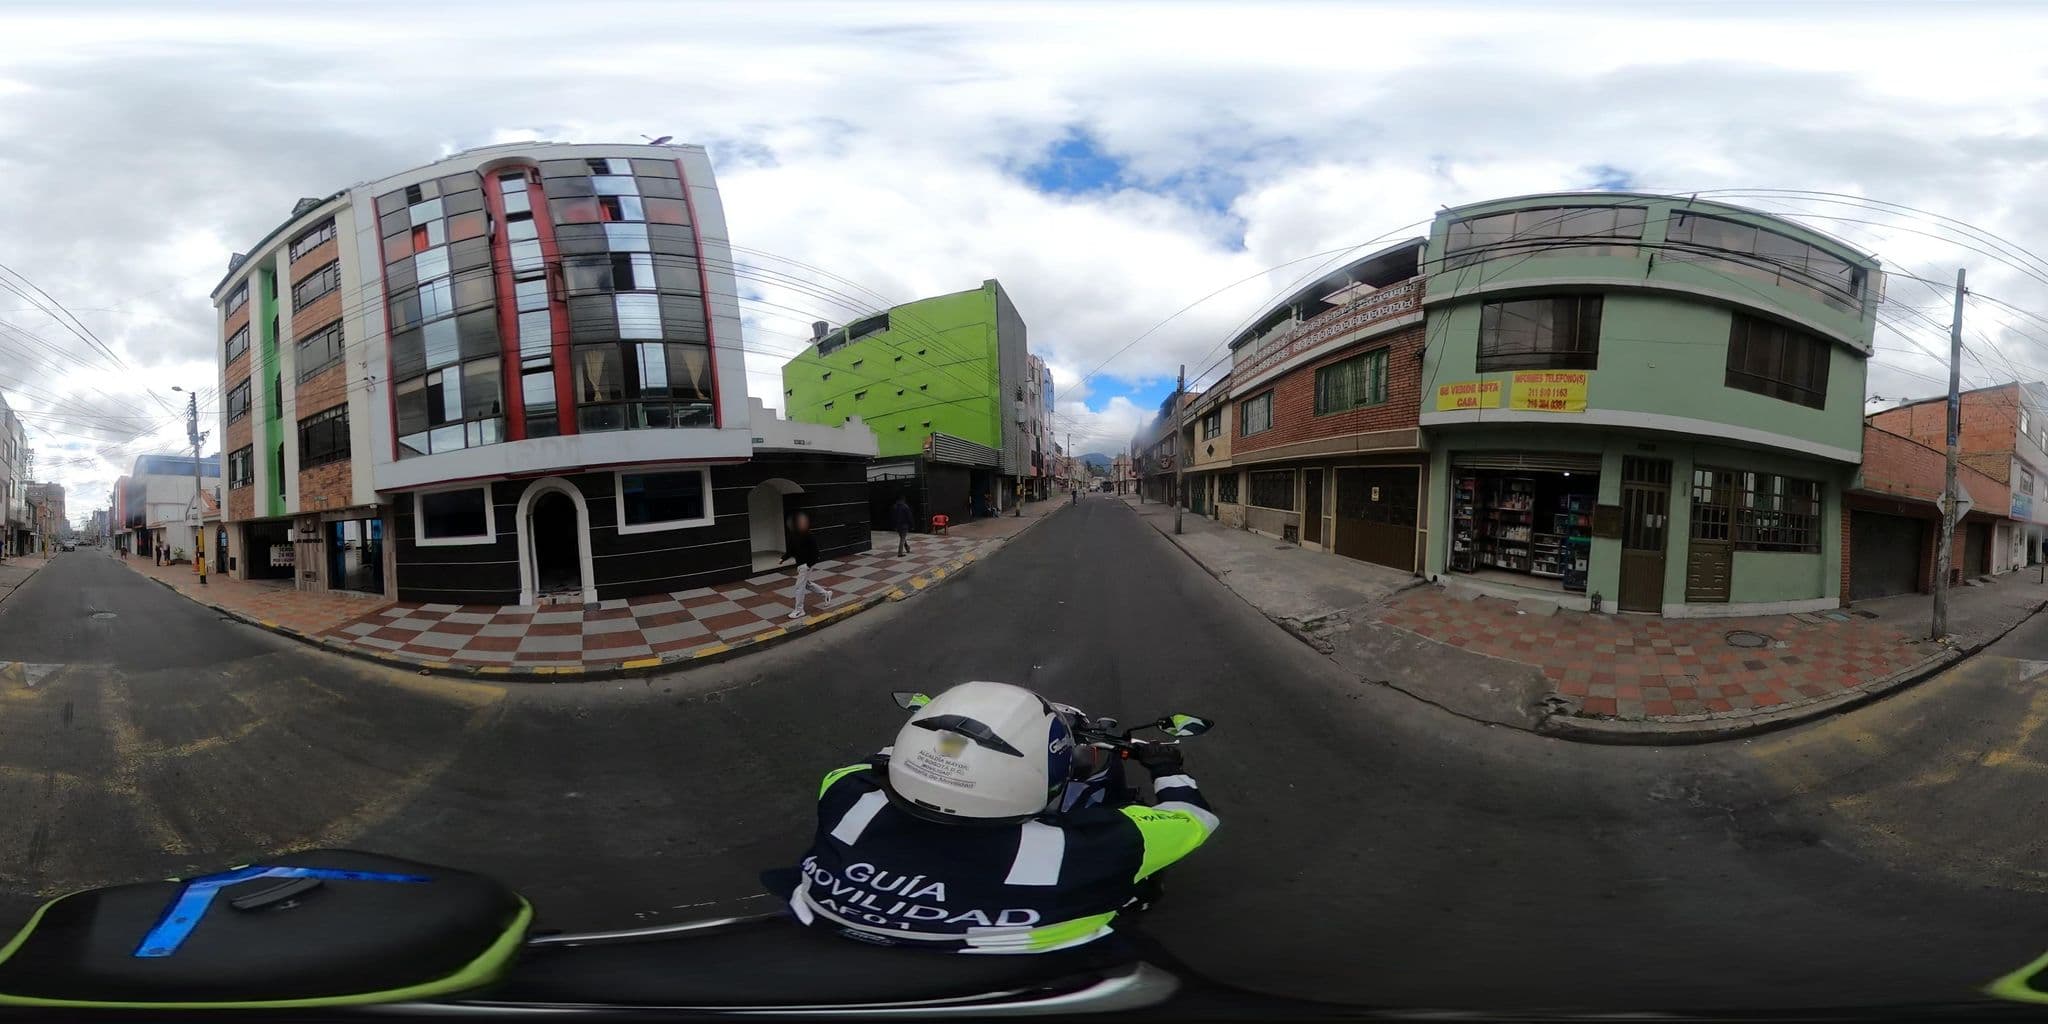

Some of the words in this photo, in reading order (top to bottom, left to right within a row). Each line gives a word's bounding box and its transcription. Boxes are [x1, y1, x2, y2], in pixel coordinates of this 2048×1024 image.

[1451, 384, 1476, 395] VENDE
[1457, 397, 1477, 407] CASA
[802, 855, 1040, 926] MOVILIDAD
[845, 862, 945, 902] GUÍA
